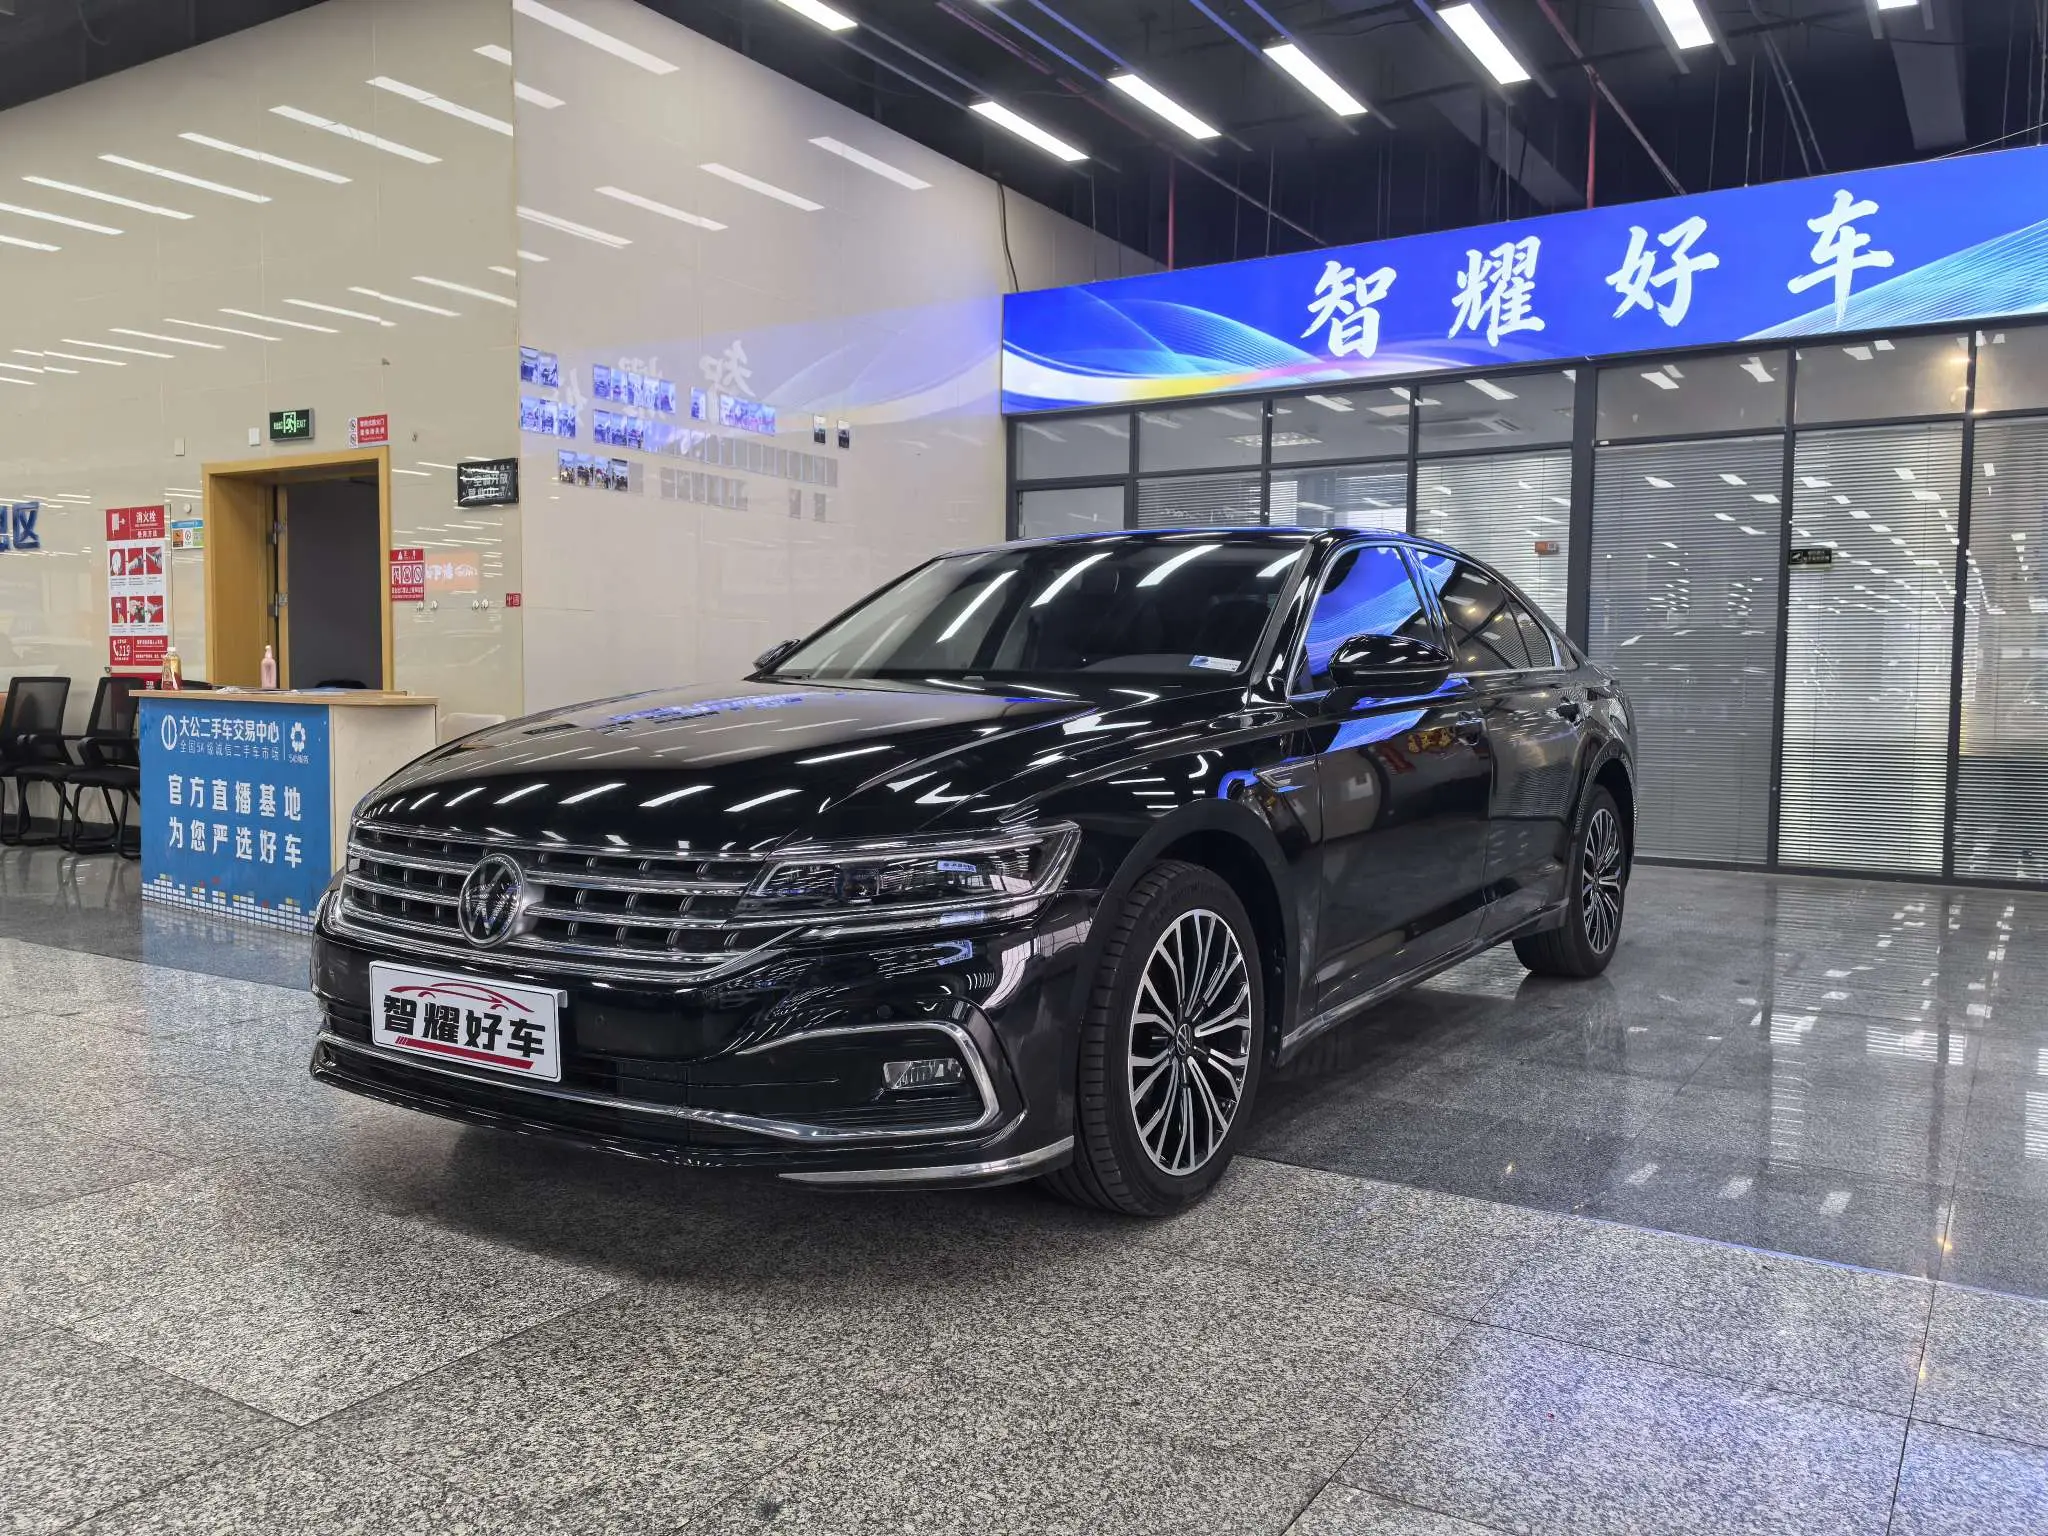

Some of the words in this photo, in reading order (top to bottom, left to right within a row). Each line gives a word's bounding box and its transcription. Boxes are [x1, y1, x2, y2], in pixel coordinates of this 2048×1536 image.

[1300, 189, 1894, 358] 智耀好车
[180, 715, 279, 743] 大公二手车交易中心
[168, 774, 301, 821] 官方直播基地
[169, 816, 302, 868] 为您严选好车
[383, 994, 546, 1058] 智耀好车
